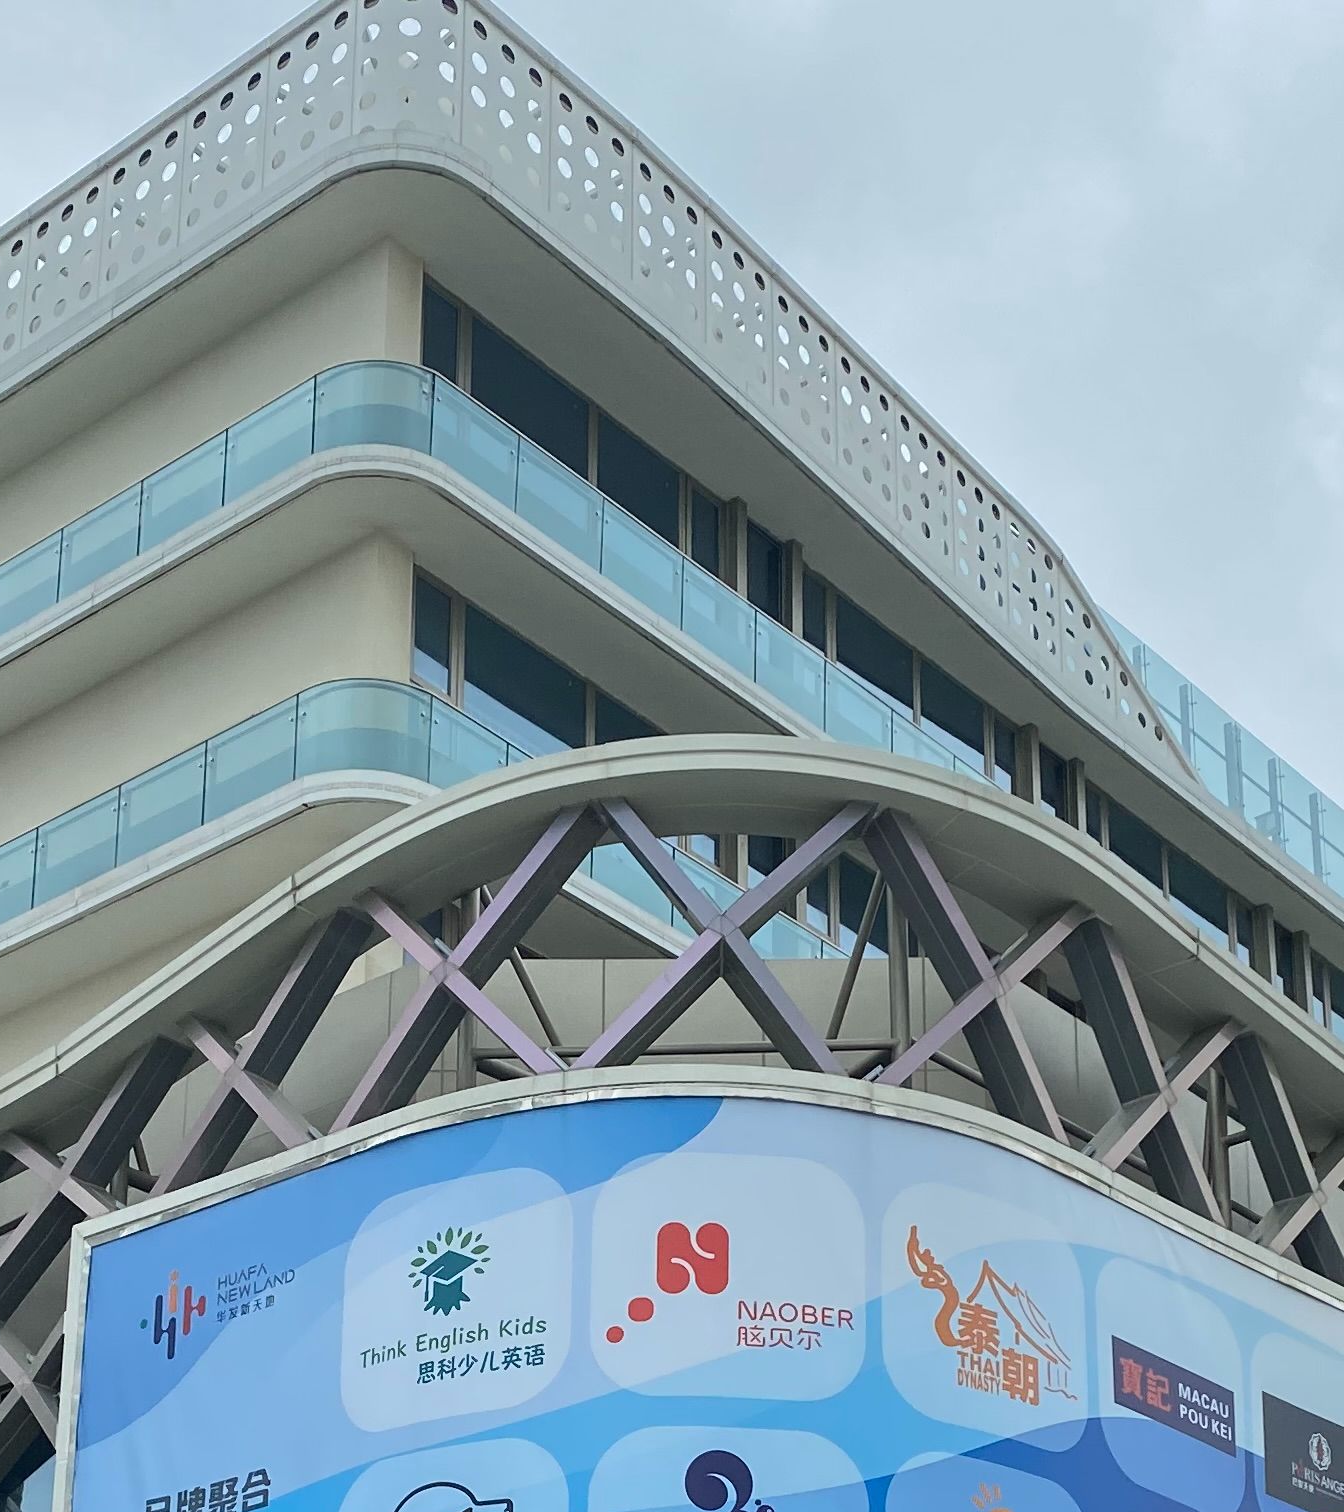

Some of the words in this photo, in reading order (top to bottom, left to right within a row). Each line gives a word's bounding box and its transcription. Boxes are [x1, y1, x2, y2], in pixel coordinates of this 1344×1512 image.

[217, 1263, 268, 1290] HUAFA
[737, 1299, 855, 1331] NAOBER
[360, 1339, 407, 1369] Think
[416, 1322, 490, 1353] English
[499, 1315, 548, 1338] Kids
[736, 1324, 823, 1351] 脑贝尔
[416, 1343, 546, 1385] 思科少儿英语
[956, 1350, 1000, 1378] THAI
[957, 1367, 1002, 1397] DYNASTY
[1178, 1382, 1230, 1419] MACAU
[1179, 1403, 1209, 1430] POU
[1211, 1418, 1233, 1442] KEI
